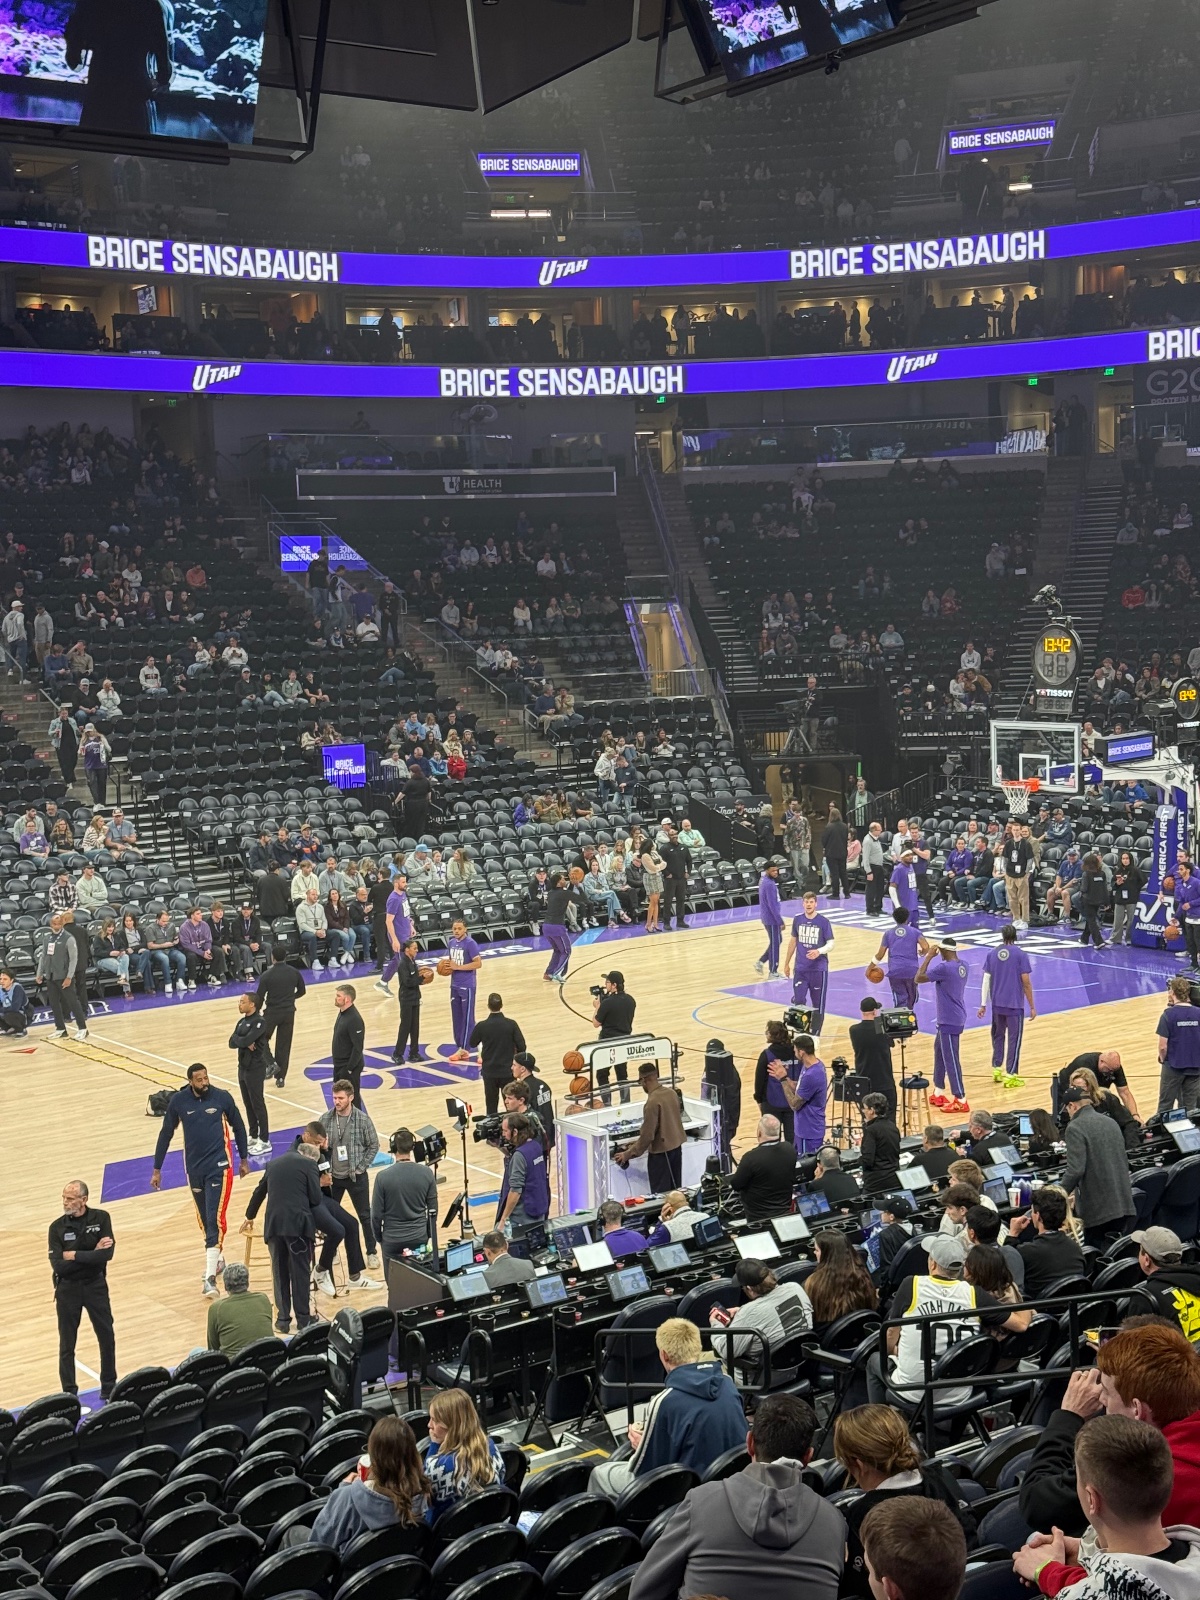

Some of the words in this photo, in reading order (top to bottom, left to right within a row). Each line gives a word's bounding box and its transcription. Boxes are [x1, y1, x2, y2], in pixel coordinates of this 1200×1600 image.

[950, 134, 981, 149] BRICE
[984, 126, 1054, 145] SENSABAUGH
[480, 159, 509, 171] BRICE
[512, 159, 578, 171] SENSABAUGH
[88, 235, 164, 272] BRICE
[171, 243, 339, 282] SENSABAUGH
[790, 247, 864, 279] BRICE
[871, 230, 1045, 274] SENSABAUGH
[539, 259, 588, 286] UTAH
[887, 352, 938, 382] UTAH
[192, 364, 241, 391] UTAH
[440, 368, 511, 396] BRICE
[517, 365, 684, 396] SENSABAUGH
[463, 479, 502, 488] HEALTH
[1044, 638, 1071, 653] 13:42
[1046, 689, 1074, 698] TISSOT
[1159, 807, 1171, 839] FIRST
[1176, 809, 1185, 841] FIRST
[1134, 922, 1165, 933] AMERICA
[626, 1045, 655, 1056] Wilson
[917, 1299, 943, 1316] UTAH
[199, 1363, 227, 1375] entrata
[297, 1369, 326, 1380] entrata
[140, 1380, 169, 1391] entrata
[236, 1382, 265, 1394] entrata
[174, 1397, 205, 1410] entrata
[47, 1405, 78, 1418] entrata
[109, 1415, 140, 1427] entrata
[41, 1430, 74, 1445] entrata
